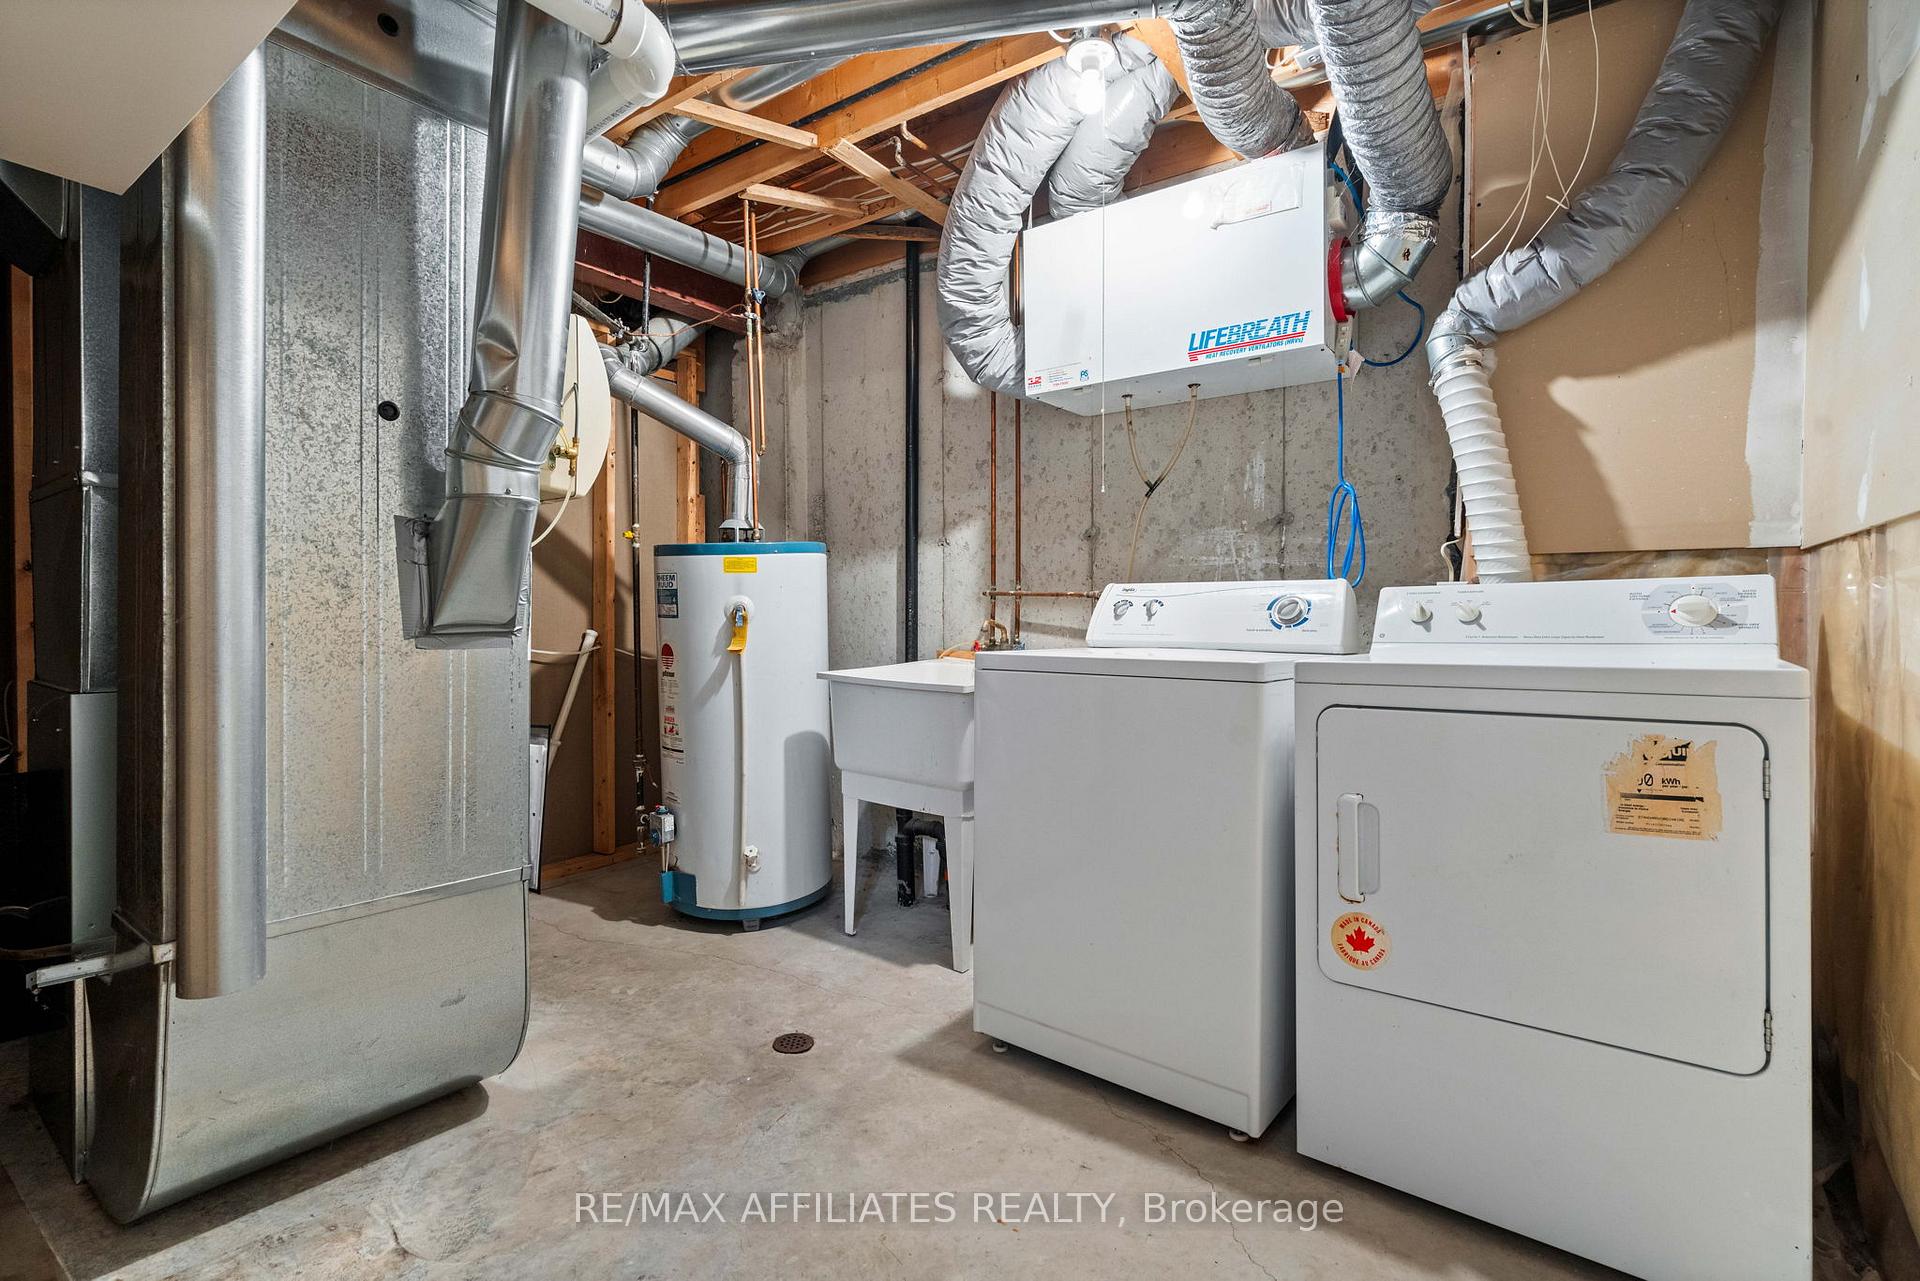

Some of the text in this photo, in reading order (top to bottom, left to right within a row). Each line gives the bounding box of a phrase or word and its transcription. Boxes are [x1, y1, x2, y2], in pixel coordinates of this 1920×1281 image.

[1188, 310, 1311, 352] LIFEBREATH
[1205, 351, 1218, 359] HEAT
[1219, 346, 1246, 356] RECOVERY
[1248, 340, 1284, 351] VENTILATORS
[1661, 777, 1681, 785] kWh
[1360, 917, 1381, 934] CANADA
